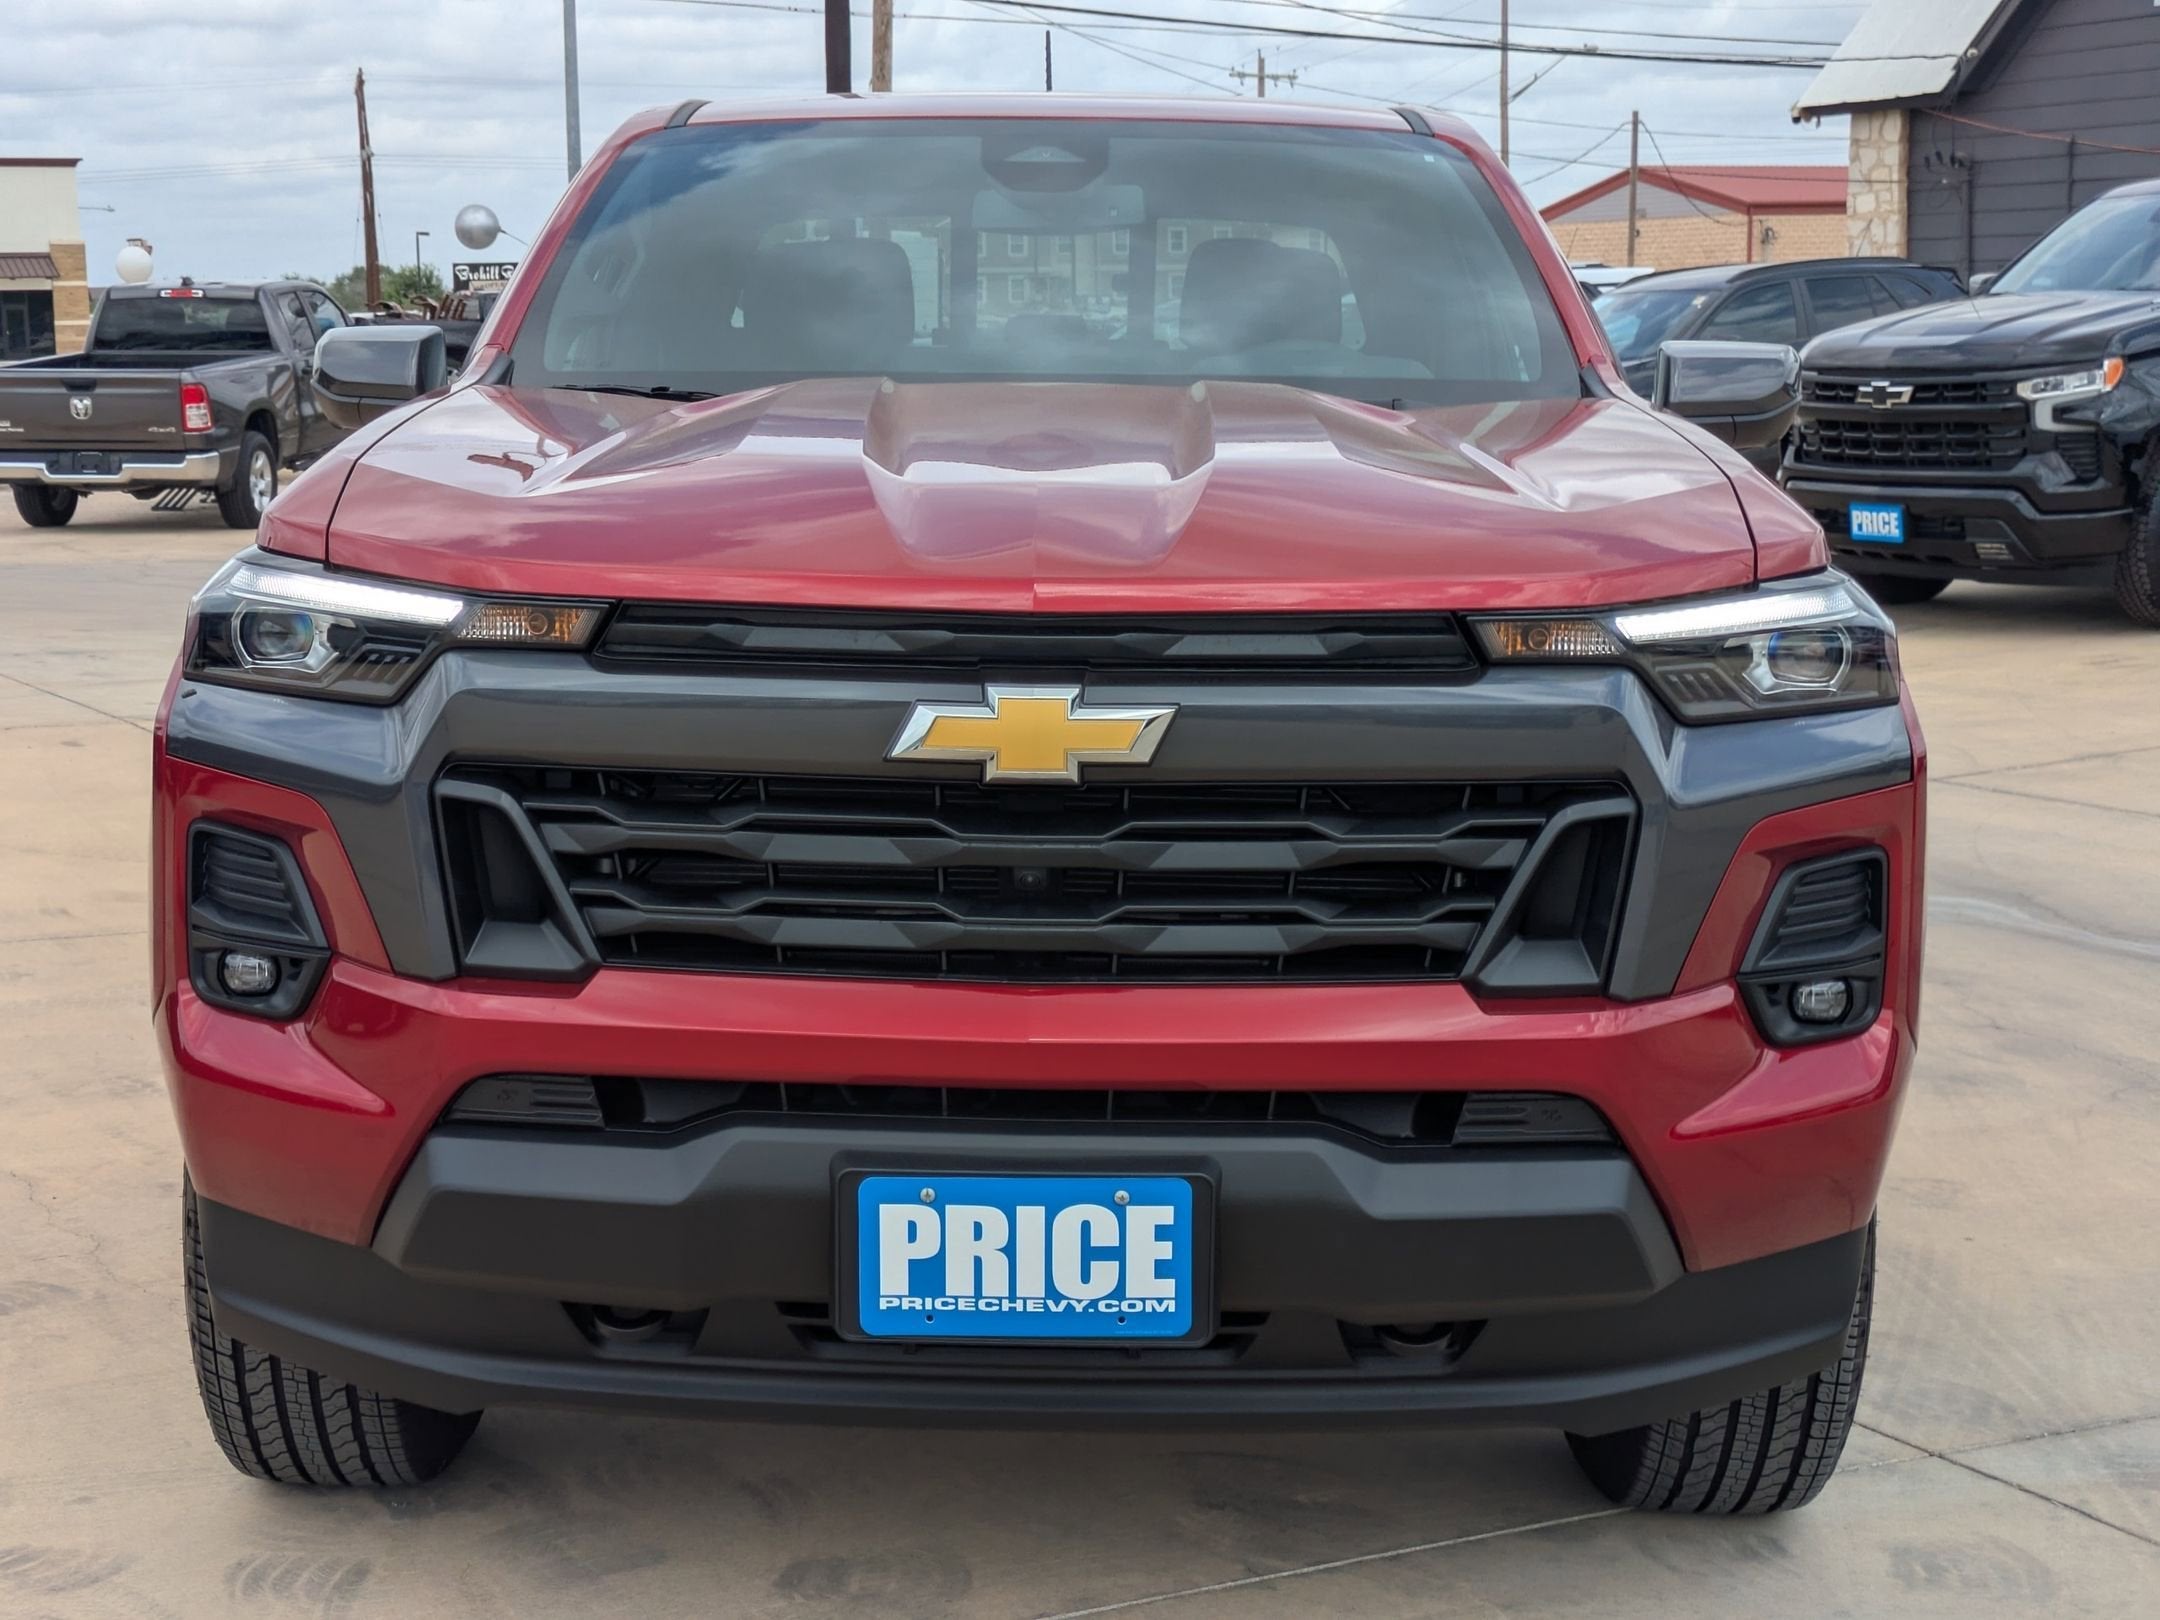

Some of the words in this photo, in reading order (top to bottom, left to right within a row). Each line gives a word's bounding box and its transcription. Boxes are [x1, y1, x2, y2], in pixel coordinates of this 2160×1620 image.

[1851, 510, 1899, 535] PRICE
[879, 1204, 1176, 1300] PRICE
[880, 1297, 1176, 1313] PRICECHEVY.COM
